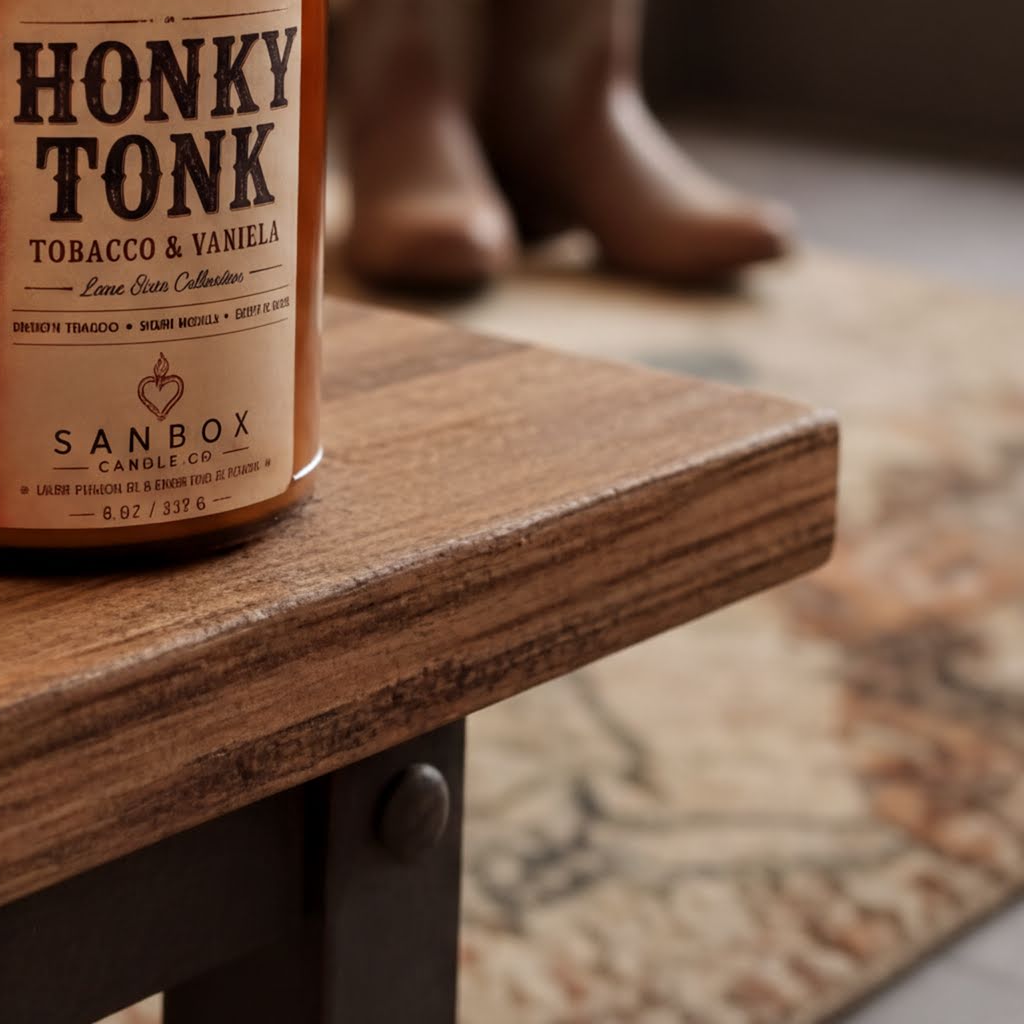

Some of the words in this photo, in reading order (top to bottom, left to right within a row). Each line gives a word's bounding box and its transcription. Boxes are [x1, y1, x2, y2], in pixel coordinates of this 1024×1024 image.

[13, 26, 298, 125] HONKY
[36, 122, 275, 222] TONK
[29, 237, 156, 264] TOBACCO
[165, 235, 183, 259] &
[53, 409, 249, 455] SANBOX
